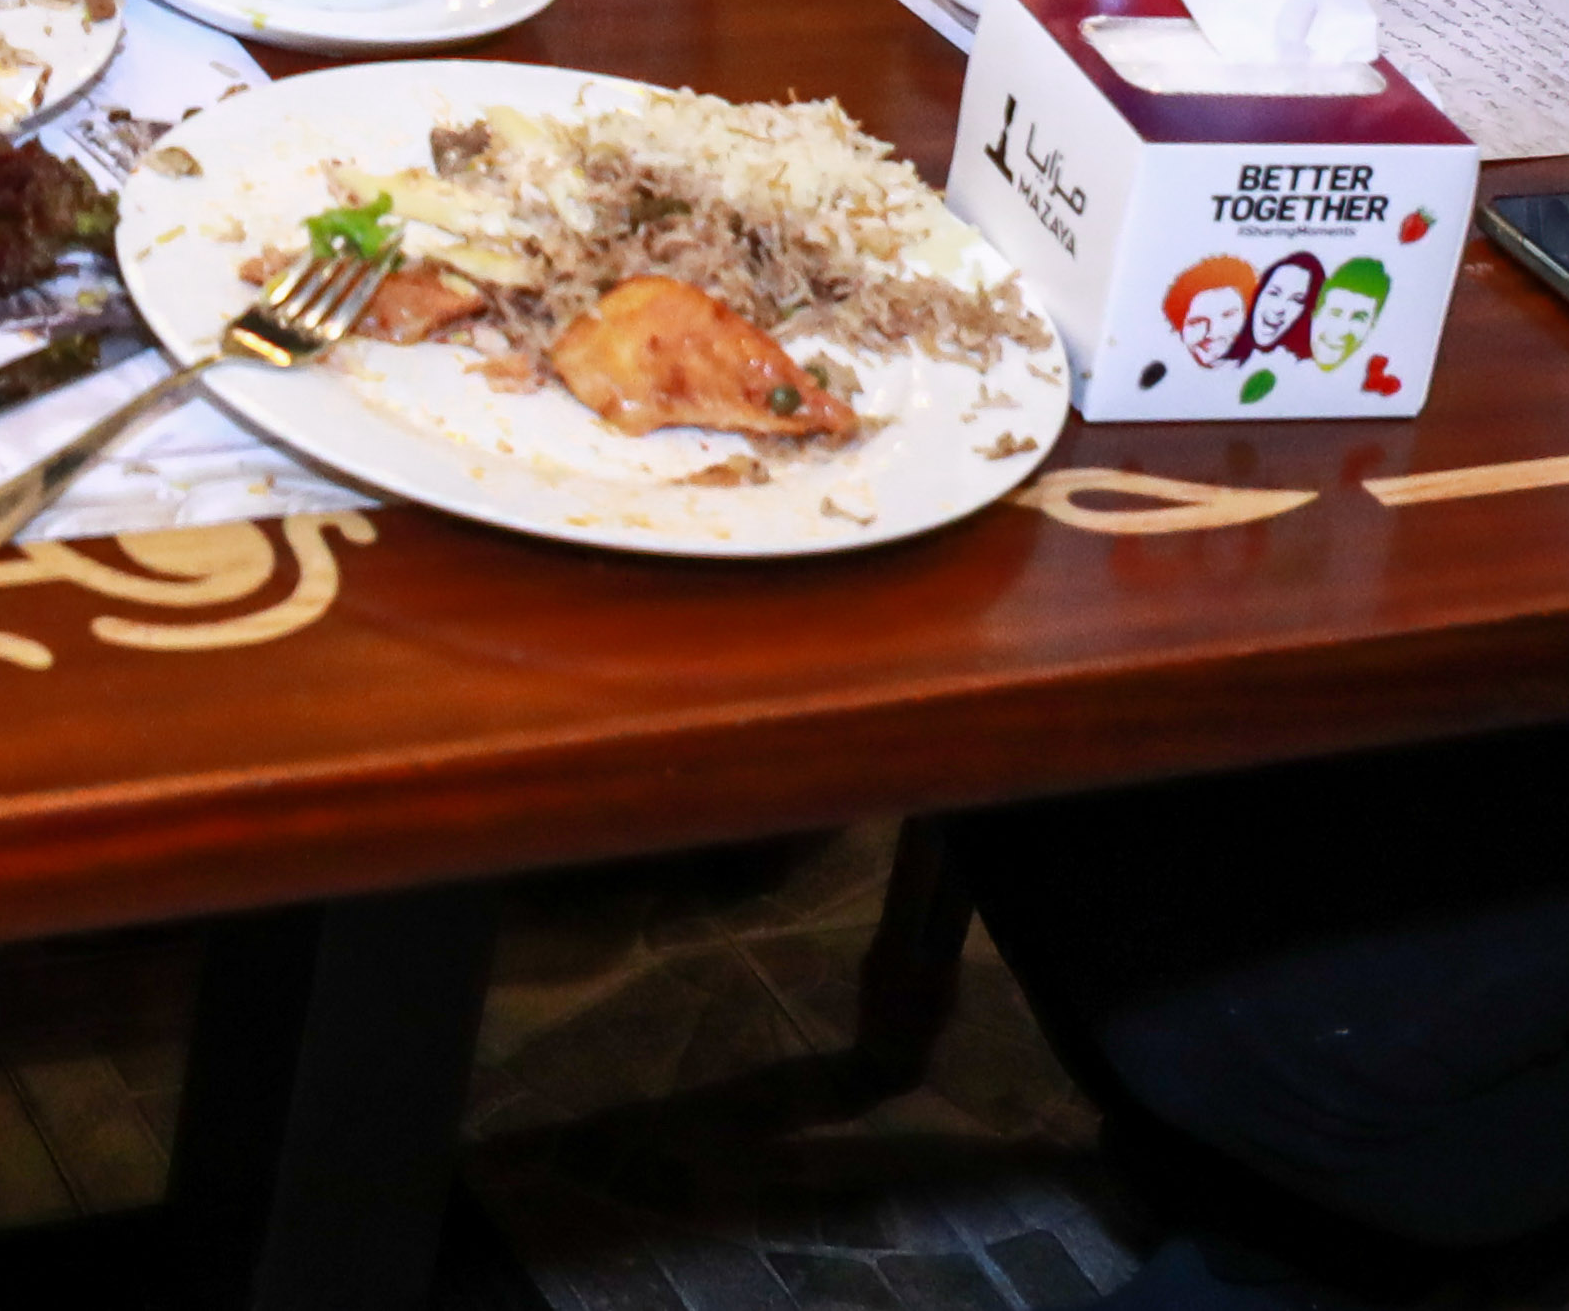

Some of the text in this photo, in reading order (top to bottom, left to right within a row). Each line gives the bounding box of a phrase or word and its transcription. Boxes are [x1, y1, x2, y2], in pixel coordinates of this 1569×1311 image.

[1026, 122, 1086, 216] مزايا
[1237, 164, 1373, 191] BETTER
[1018, 174, 1075, 260] MAZAYA
[1211, 194, 1389, 221] TOGETHER
